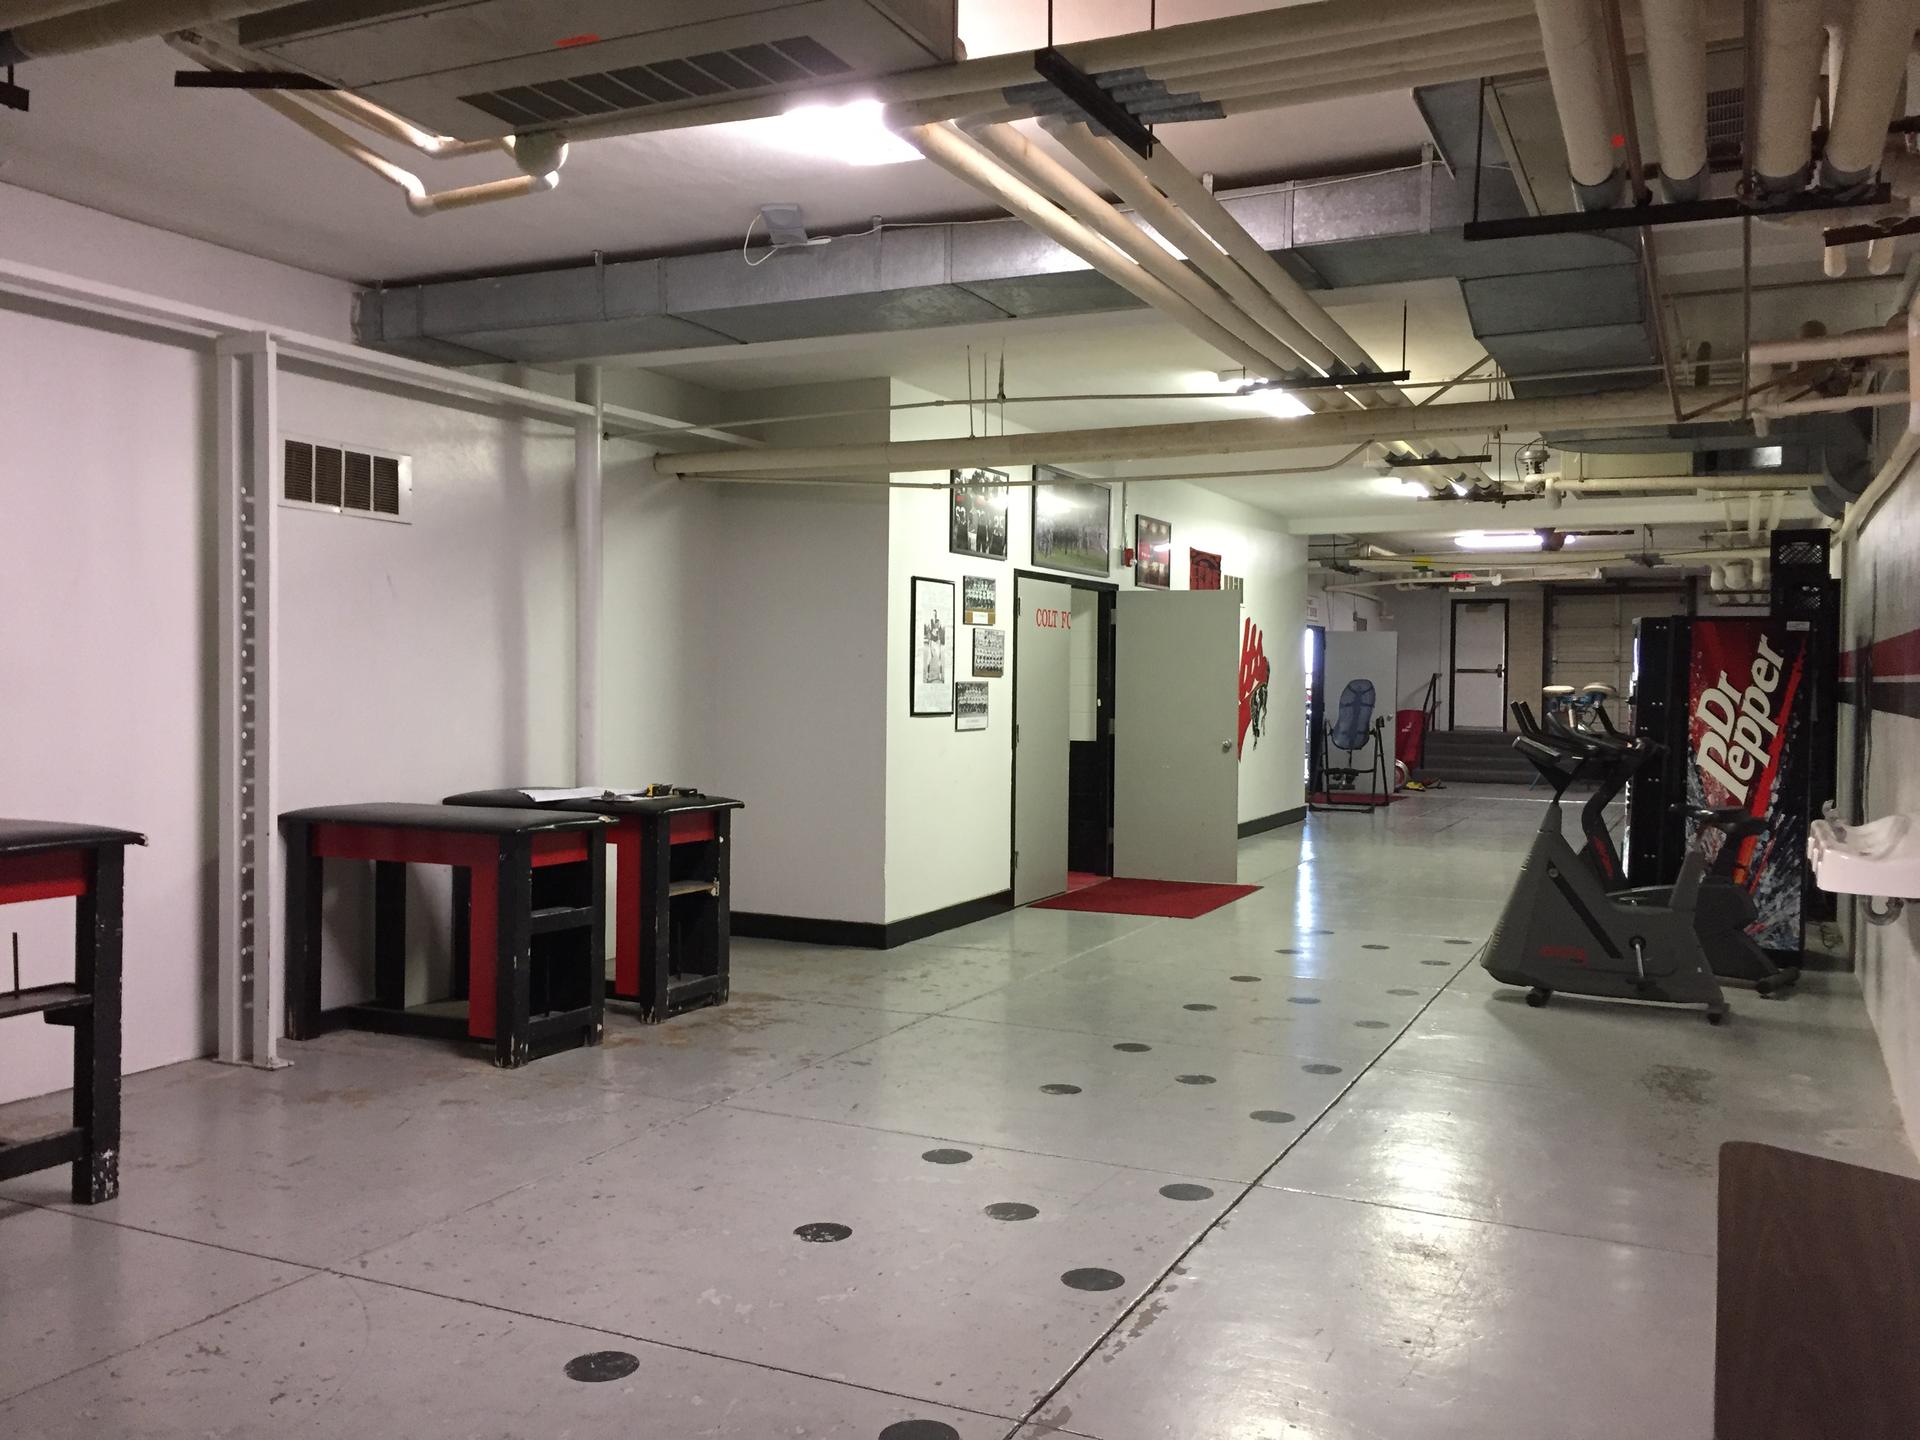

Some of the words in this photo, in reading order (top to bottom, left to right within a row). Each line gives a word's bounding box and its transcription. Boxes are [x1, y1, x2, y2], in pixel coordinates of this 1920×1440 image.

[1036, 608, 1058, 628] COLT
[1697, 671, 1742, 743] Dr
[1697, 635, 1784, 805] Pepper
